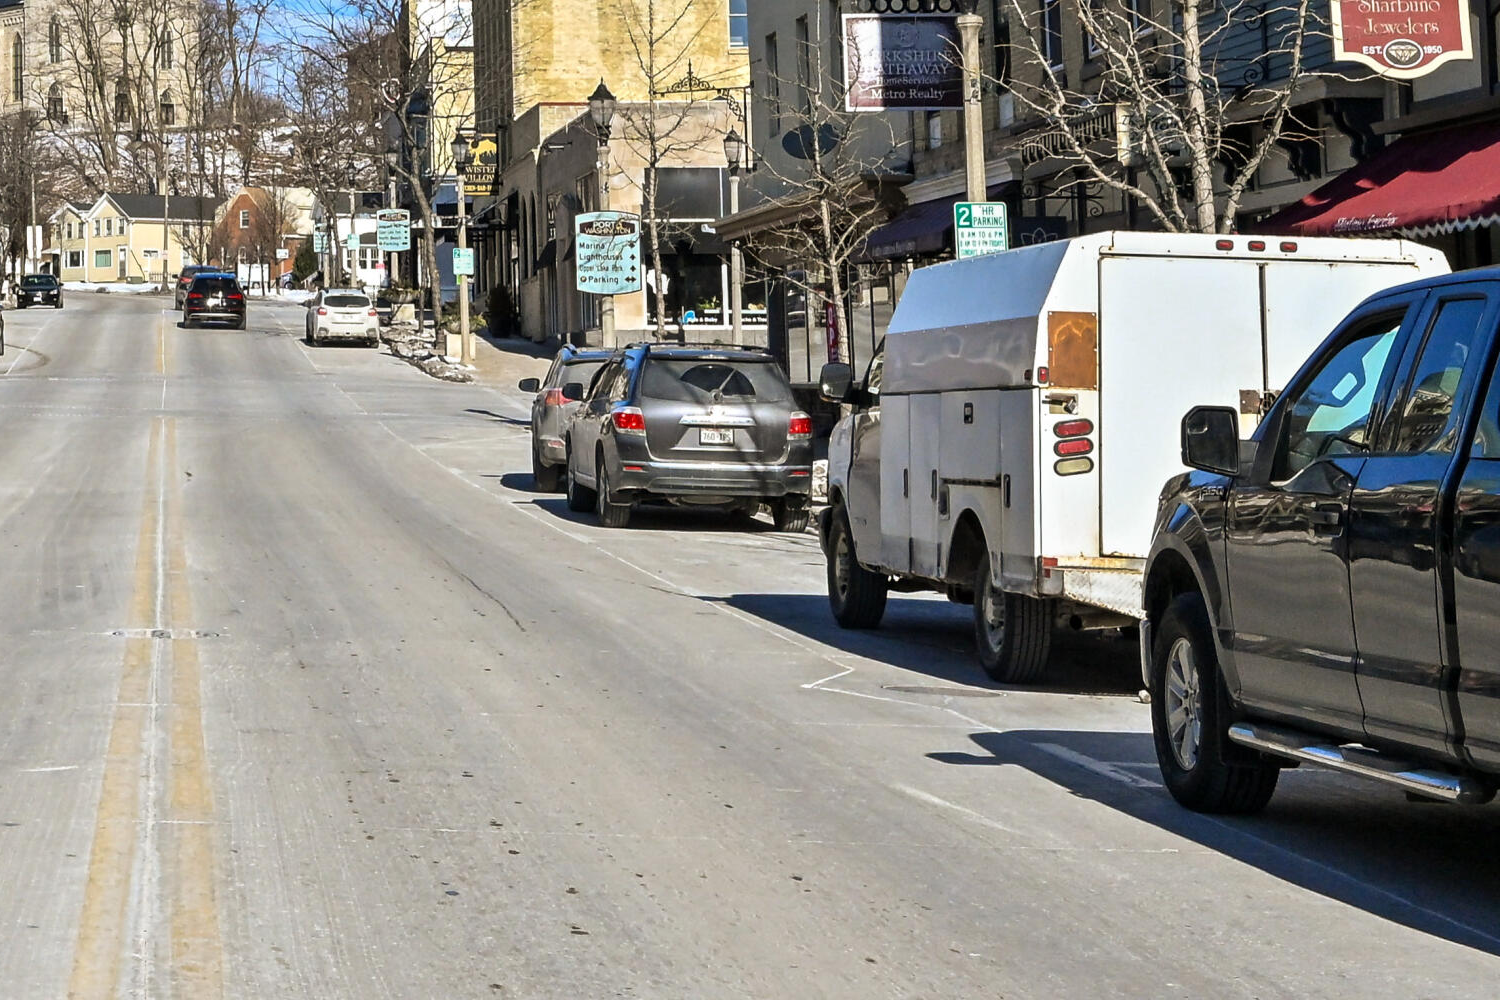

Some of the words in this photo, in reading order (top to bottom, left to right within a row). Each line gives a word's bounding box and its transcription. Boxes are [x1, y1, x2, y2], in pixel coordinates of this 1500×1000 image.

[1364, 17, 1439, 35] Jewelers
[869, 49, 953, 61] RKSHIRE
[1362, 45, 1383, 55] EST.
[1423, 45, 1443, 54] 1950
[872, 63, 950, 75] ATHAWAY
[871, 89, 906, 99] Metro
[909, 88, 946, 100] Realty
[958, 207, 971, 226] 2
[982, 206, 994, 215] HR
[593, 221, 615, 229] PORT
[973, 217, 1004, 226] PARKING
[979, 231, 986, 239] TO
[579, 242, 605, 250] Marina
[588, 276, 619, 285] Parking
